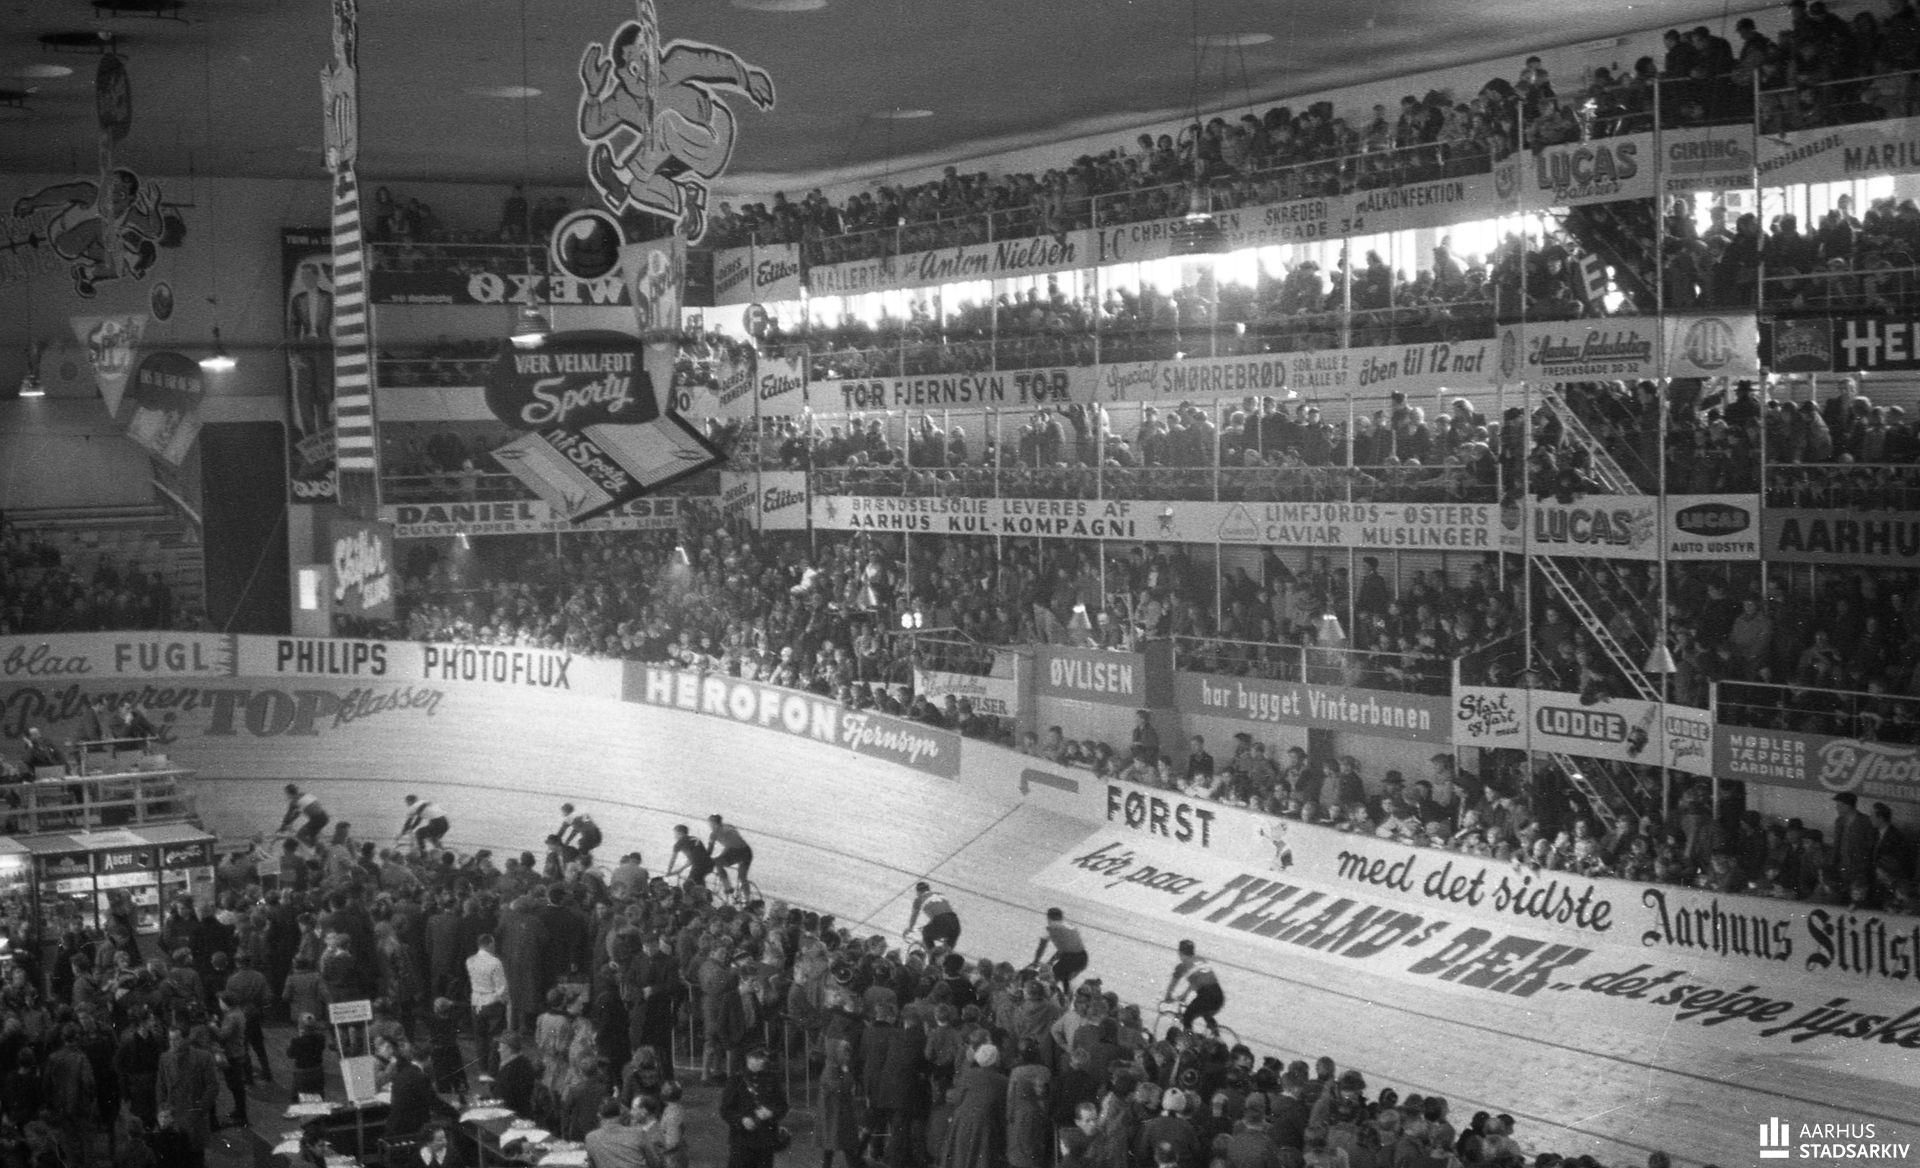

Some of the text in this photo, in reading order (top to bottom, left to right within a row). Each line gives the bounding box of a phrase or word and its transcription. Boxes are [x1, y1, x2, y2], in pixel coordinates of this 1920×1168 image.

[1536, 142, 1638, 190] LUCAS
[757, 259, 799, 288] Editor
[917, 247, 988, 281] Anton
[992, 236, 1077, 275] Nielsen
[514, 352, 635, 374] VÆR VELKLÆDT
[1163, 361, 1286, 393] SMØRREBRØD
[1358, 344, 1486, 387] åben til 12 nat
[521, 372, 634, 424] Sporty
[760, 373, 803, 401] Editor
[841, 369, 1070, 410] TOR FJERNSYN TOR
[397, 502, 536, 525] DANIEL
[763, 486, 805, 513] Editor
[852, 496, 1131, 518] BRÆNDSELSOLIE LEVERES AF
[1266, 504, 1489, 525] LIMFJORDS ØSTERS
[850, 513, 931, 530] AARHUS
[1265, 525, 1341, 544] CAVIAR
[1362, 527, 1490, 547] MUSLINGER
[1534, 508, 1632, 546] LUCAS
[1680, 511, 1746, 529] LUCAS
[1778, 517, 1920, 553] AARHU
[1671, 542, 1755, 553] AUTO UDSTYR
[3, 643, 209, 677] blaa FUGL
[277, 640, 571, 690] PHILIPS PHOTOFLUX
[1050, 656, 1133, 695] ØVLISEN
[204, 688, 338, 738] TOP
[331, 685, 444, 729] klassen
[646, 667, 939, 763] HEROFON Fjernsyn
[1201, 679, 1432, 731] har bygget Vinterbanen
[1542, 709, 1624, 742] LODGE
[1729, 734, 1806, 754] MØBLER
[1731, 748, 1806, 768] TÆPPER
[1106, 784, 1216, 848] FØRST
[1337, 850, 1416, 893] med
[1423, 861, 1486, 906] det
[1492, 875, 1612, 932] sidste
[1103, 865, 1203, 895] paa
[1406, 926, 1593, 998] DÆK
